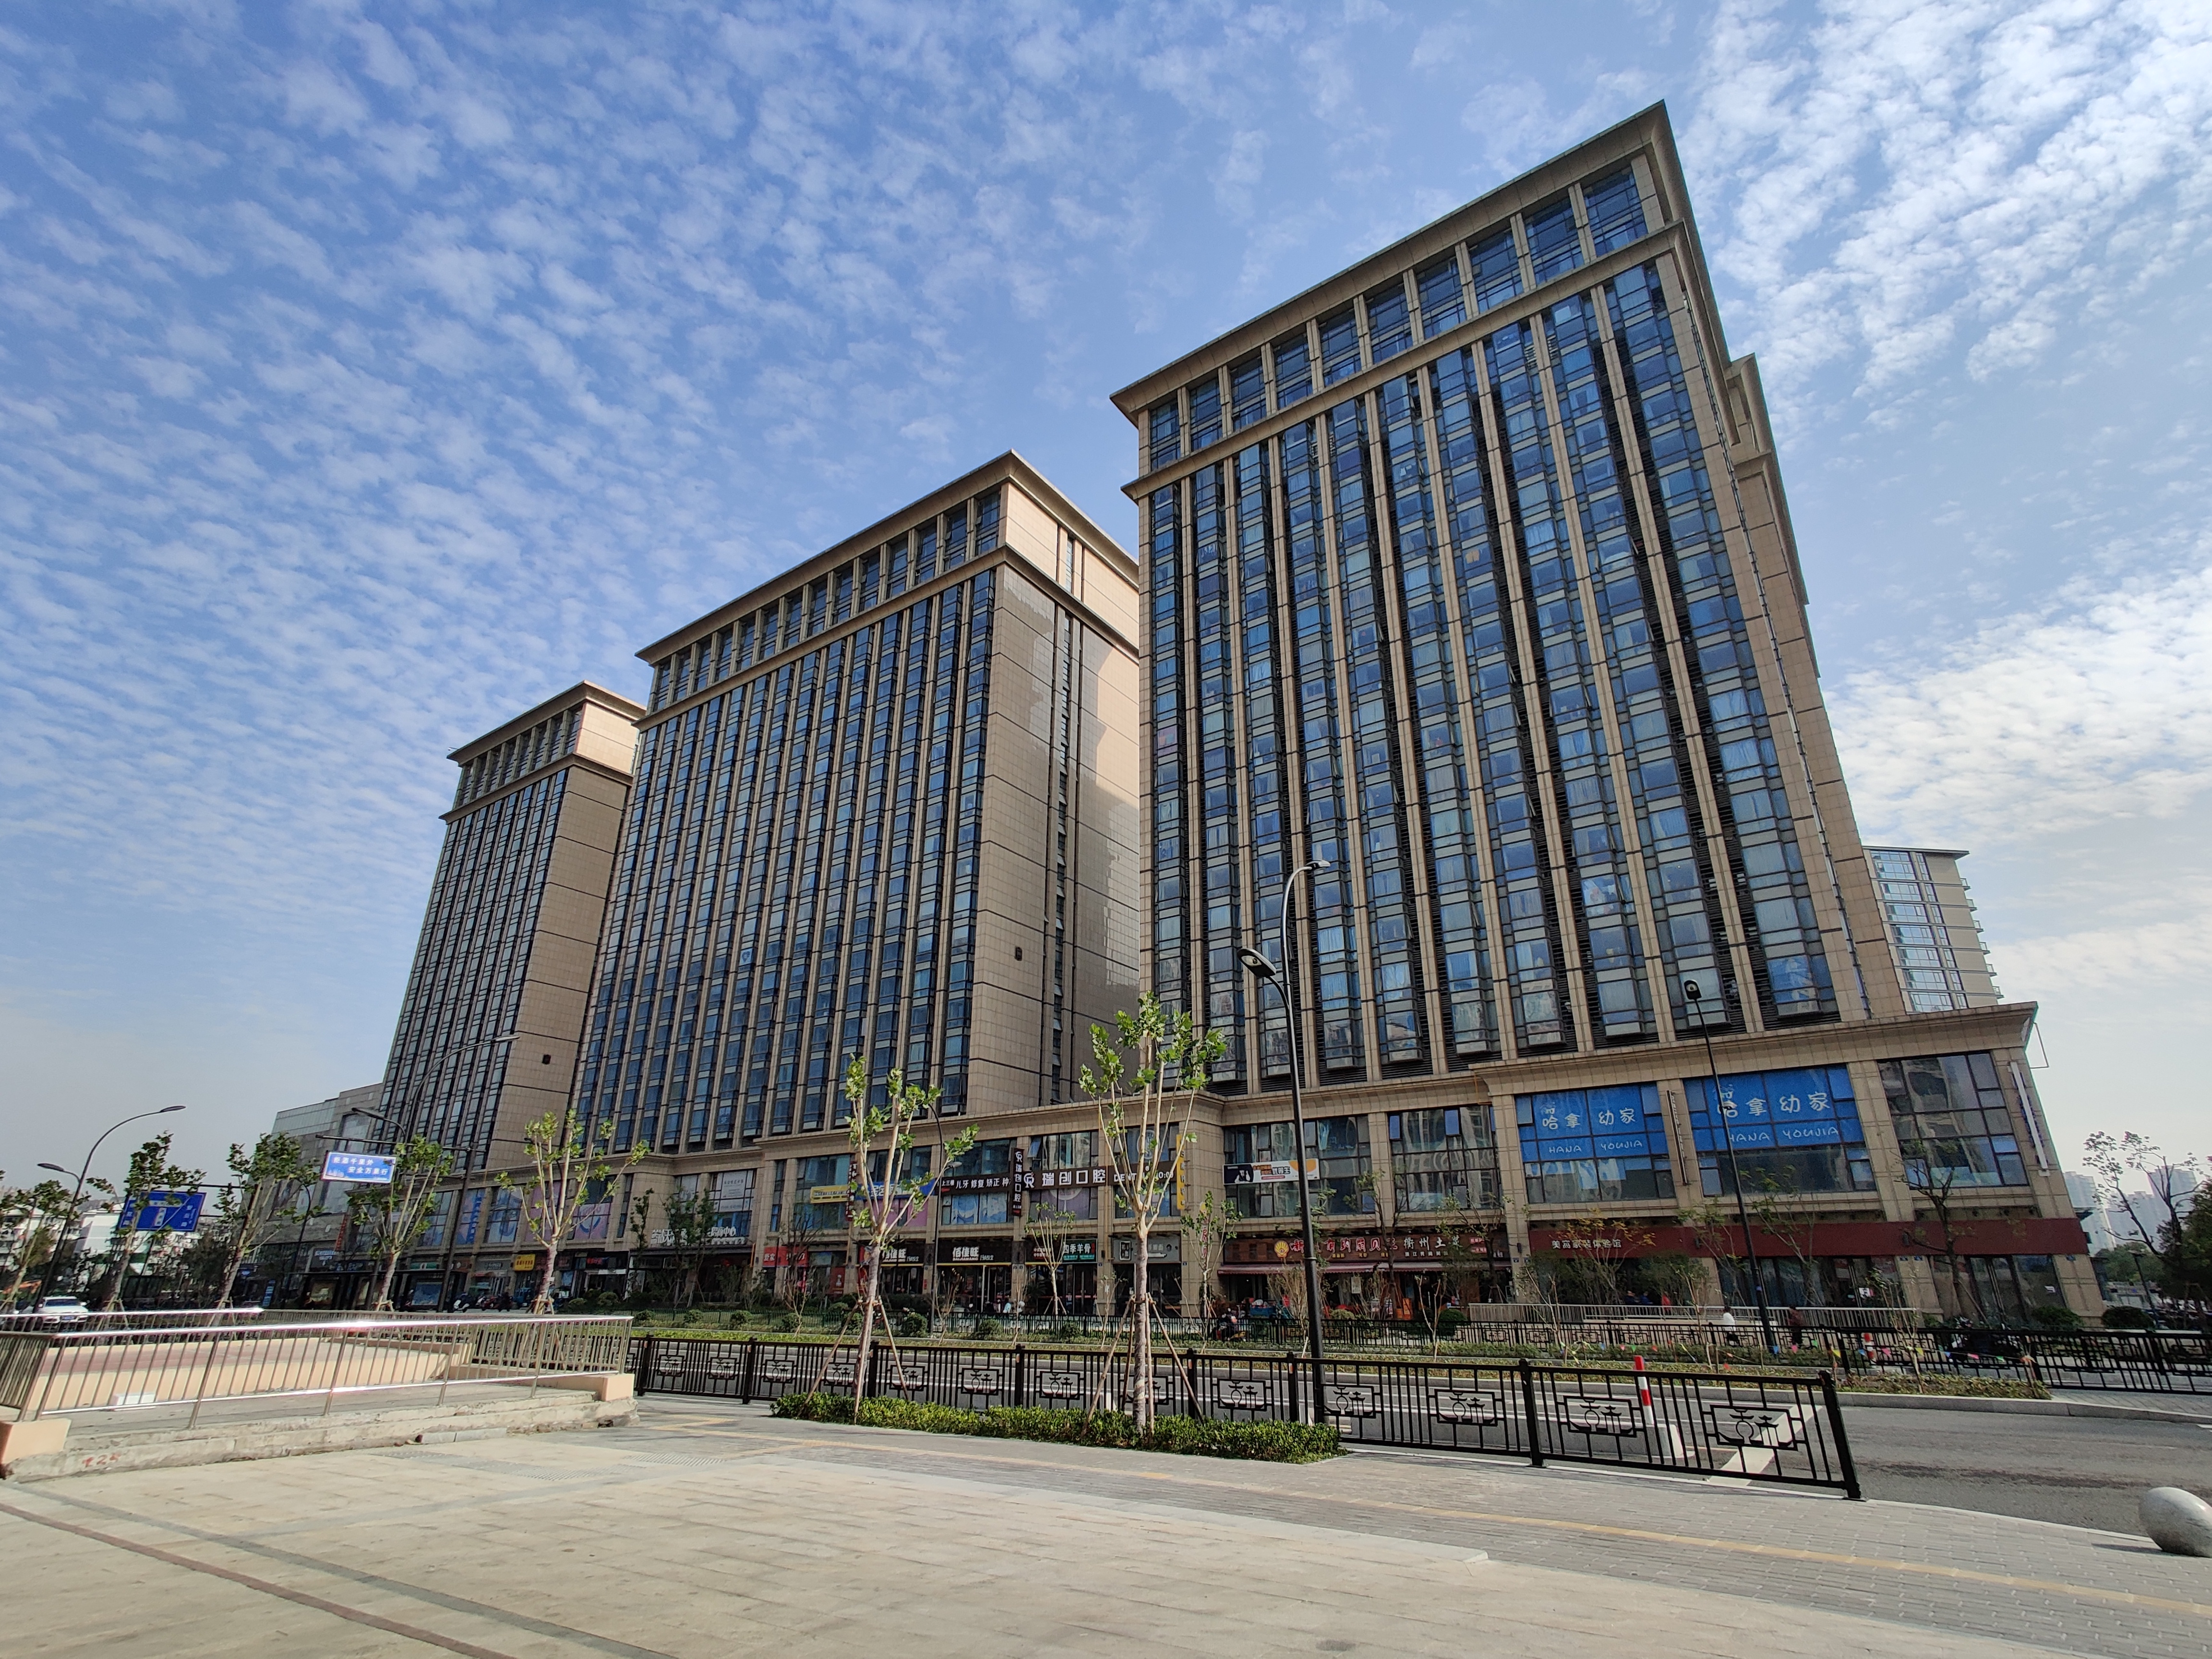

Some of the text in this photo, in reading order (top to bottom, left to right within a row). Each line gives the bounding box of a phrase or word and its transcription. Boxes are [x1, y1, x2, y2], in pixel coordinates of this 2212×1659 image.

[1542, 1107, 1636, 1130] 哈拿幼家
[1782, 1127, 1839, 1140] YOUJIA
[1549, 1140, 1643, 1154] HANA YOUJIA
[348, 1166, 388, 1175] 安全万里行
[956, 1177, 1011, 1189] 儿牙 修复 矫正 种
[1014, 1164, 1022, 1202] 瑞创口腔
[1042, 1169, 1106, 1187] 瑞创口腔
[1063, 1243, 1091, 1254] 四季羊骨
